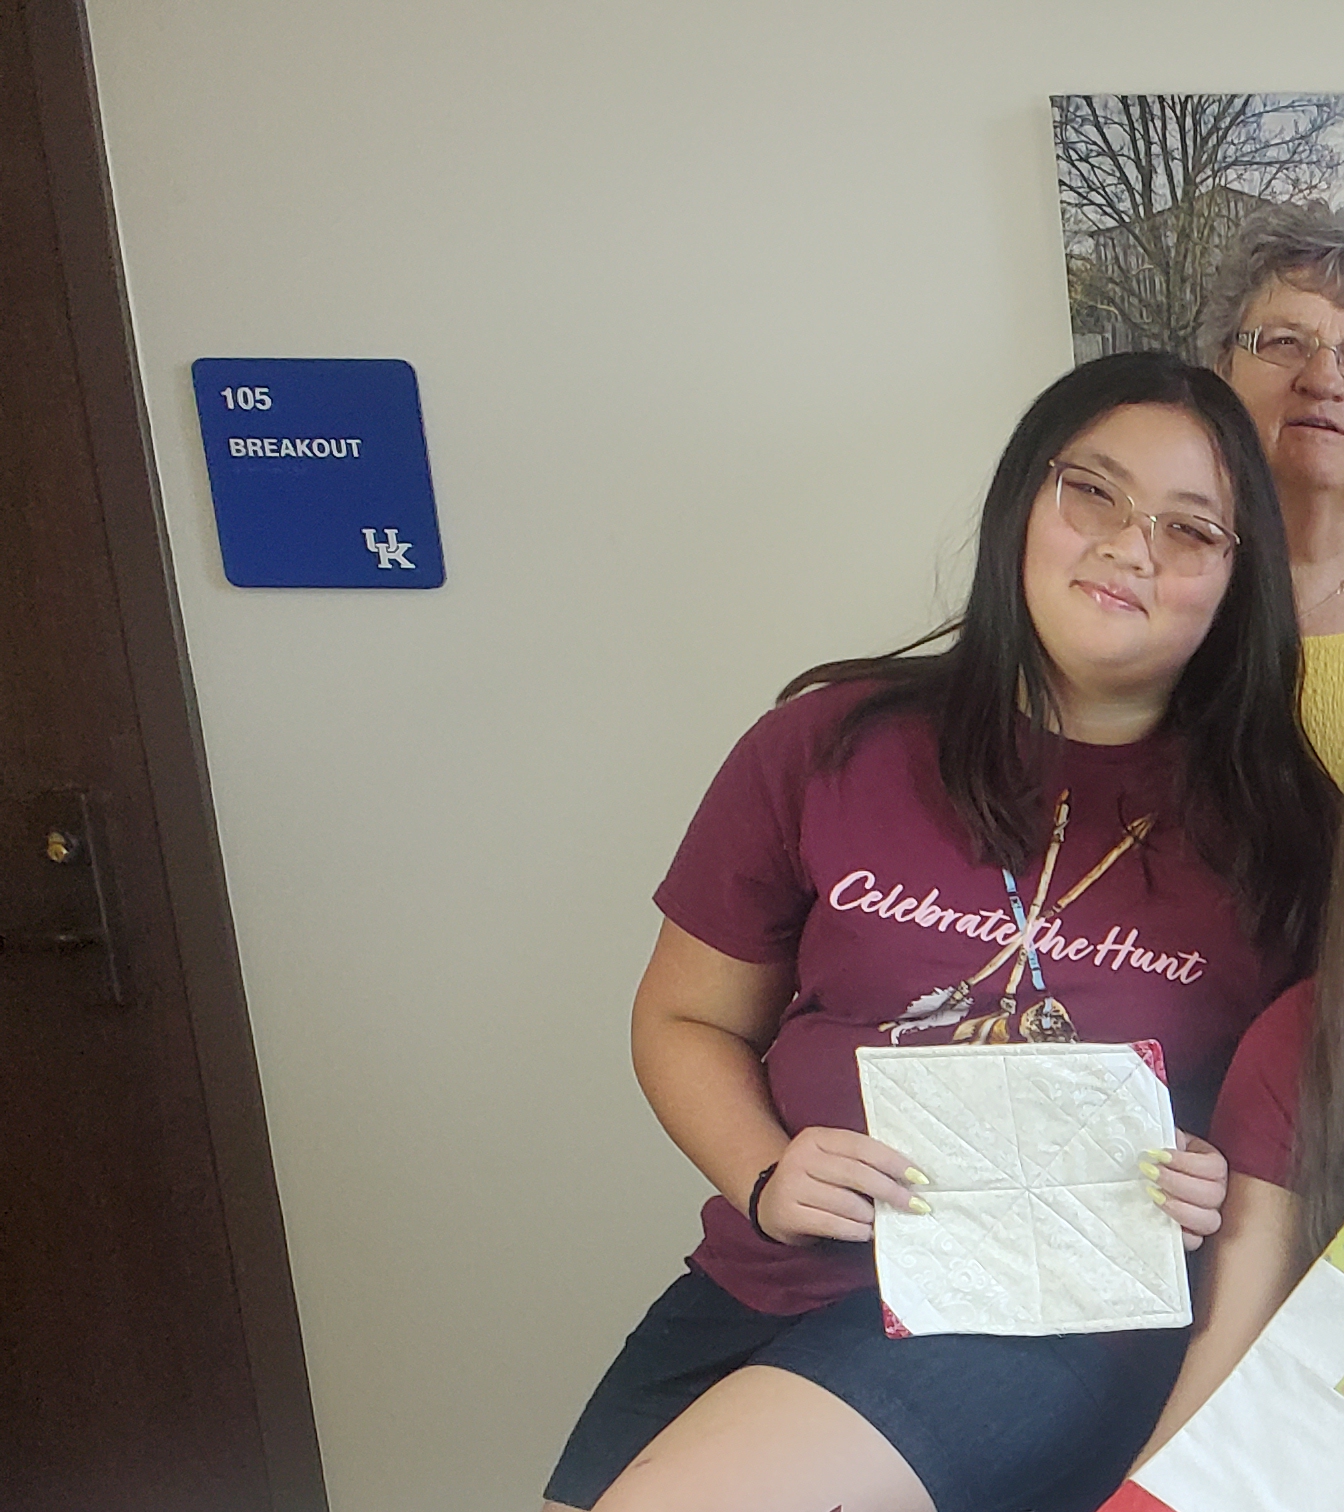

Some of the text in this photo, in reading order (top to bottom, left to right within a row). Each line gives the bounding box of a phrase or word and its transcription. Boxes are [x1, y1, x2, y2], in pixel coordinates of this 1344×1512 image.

[221, 386, 272, 410] 105
[228, 438, 362, 458] BREAKOUT
[361, 528, 416, 568] UK
[829, 870, 1208, 985] Celebrate the Hunt
